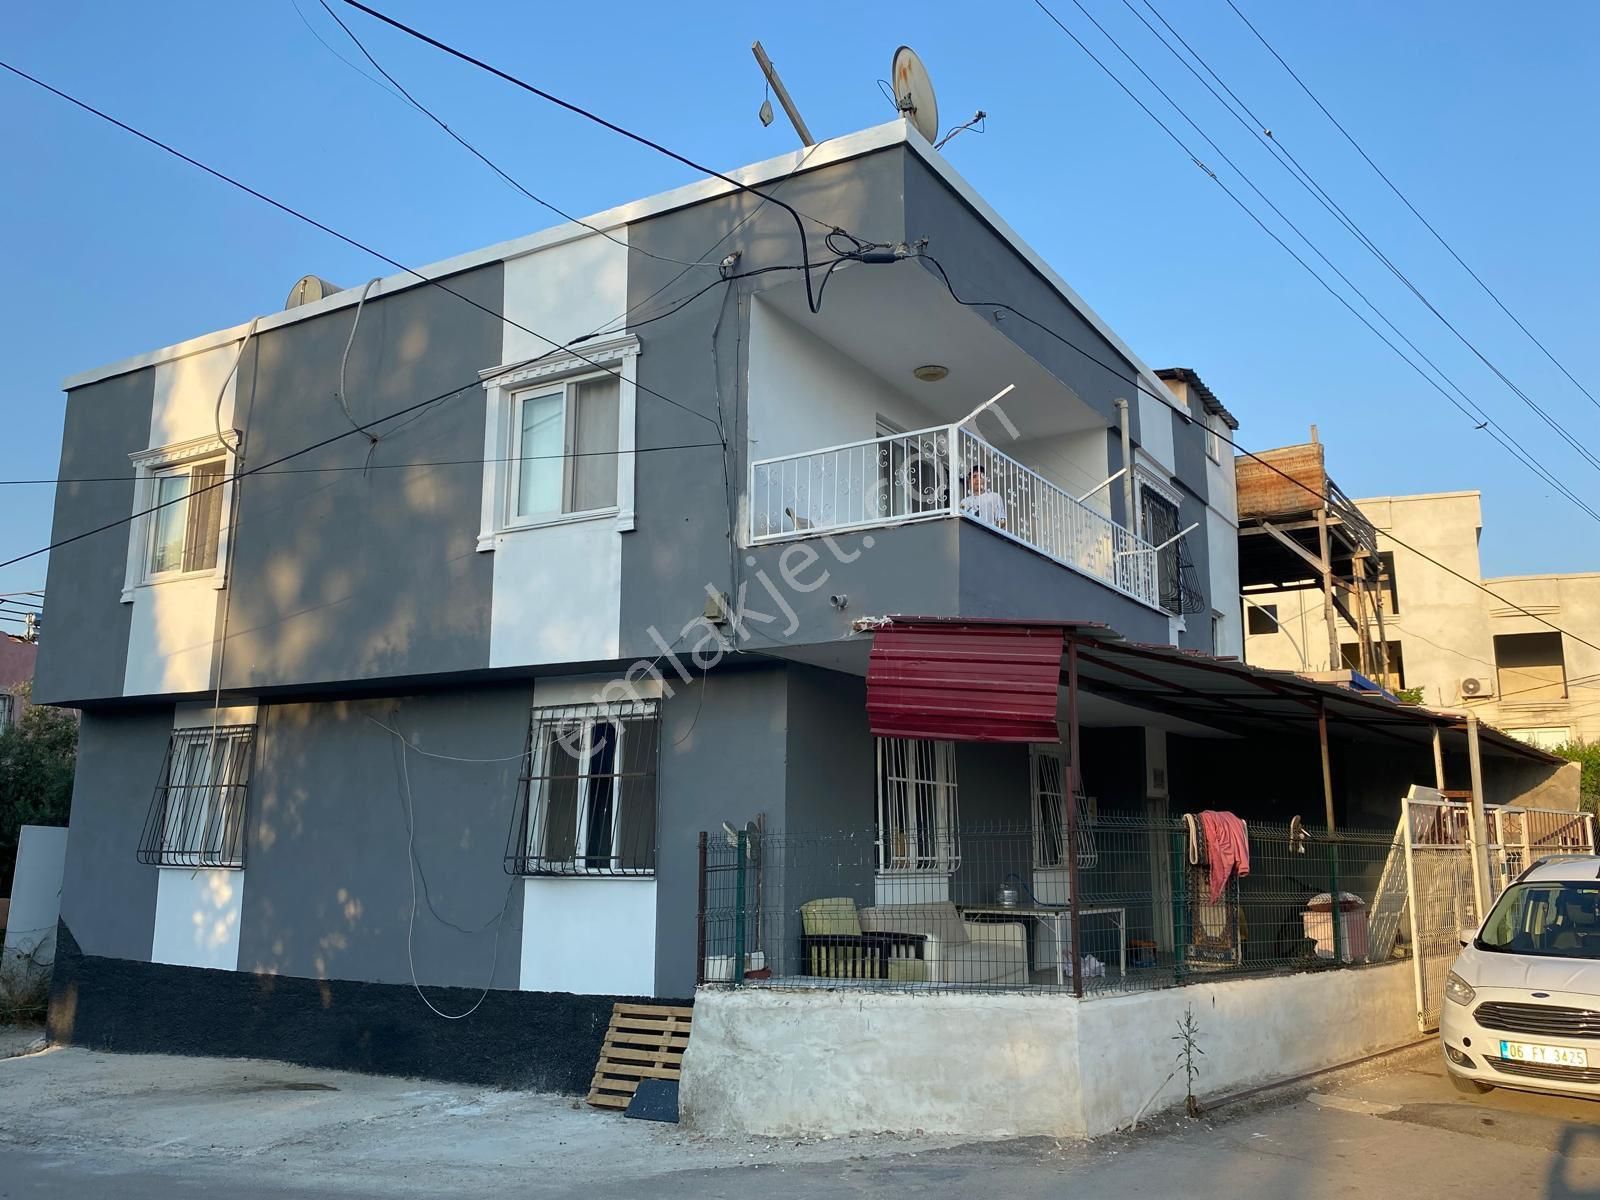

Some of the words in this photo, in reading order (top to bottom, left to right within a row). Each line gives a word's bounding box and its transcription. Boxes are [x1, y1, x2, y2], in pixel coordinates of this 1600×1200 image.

[1509, 1044, 1524, 1058] 06
[1532, 1046, 1546, 1060] FY
[1553, 1049, 1585, 1065] 3425
